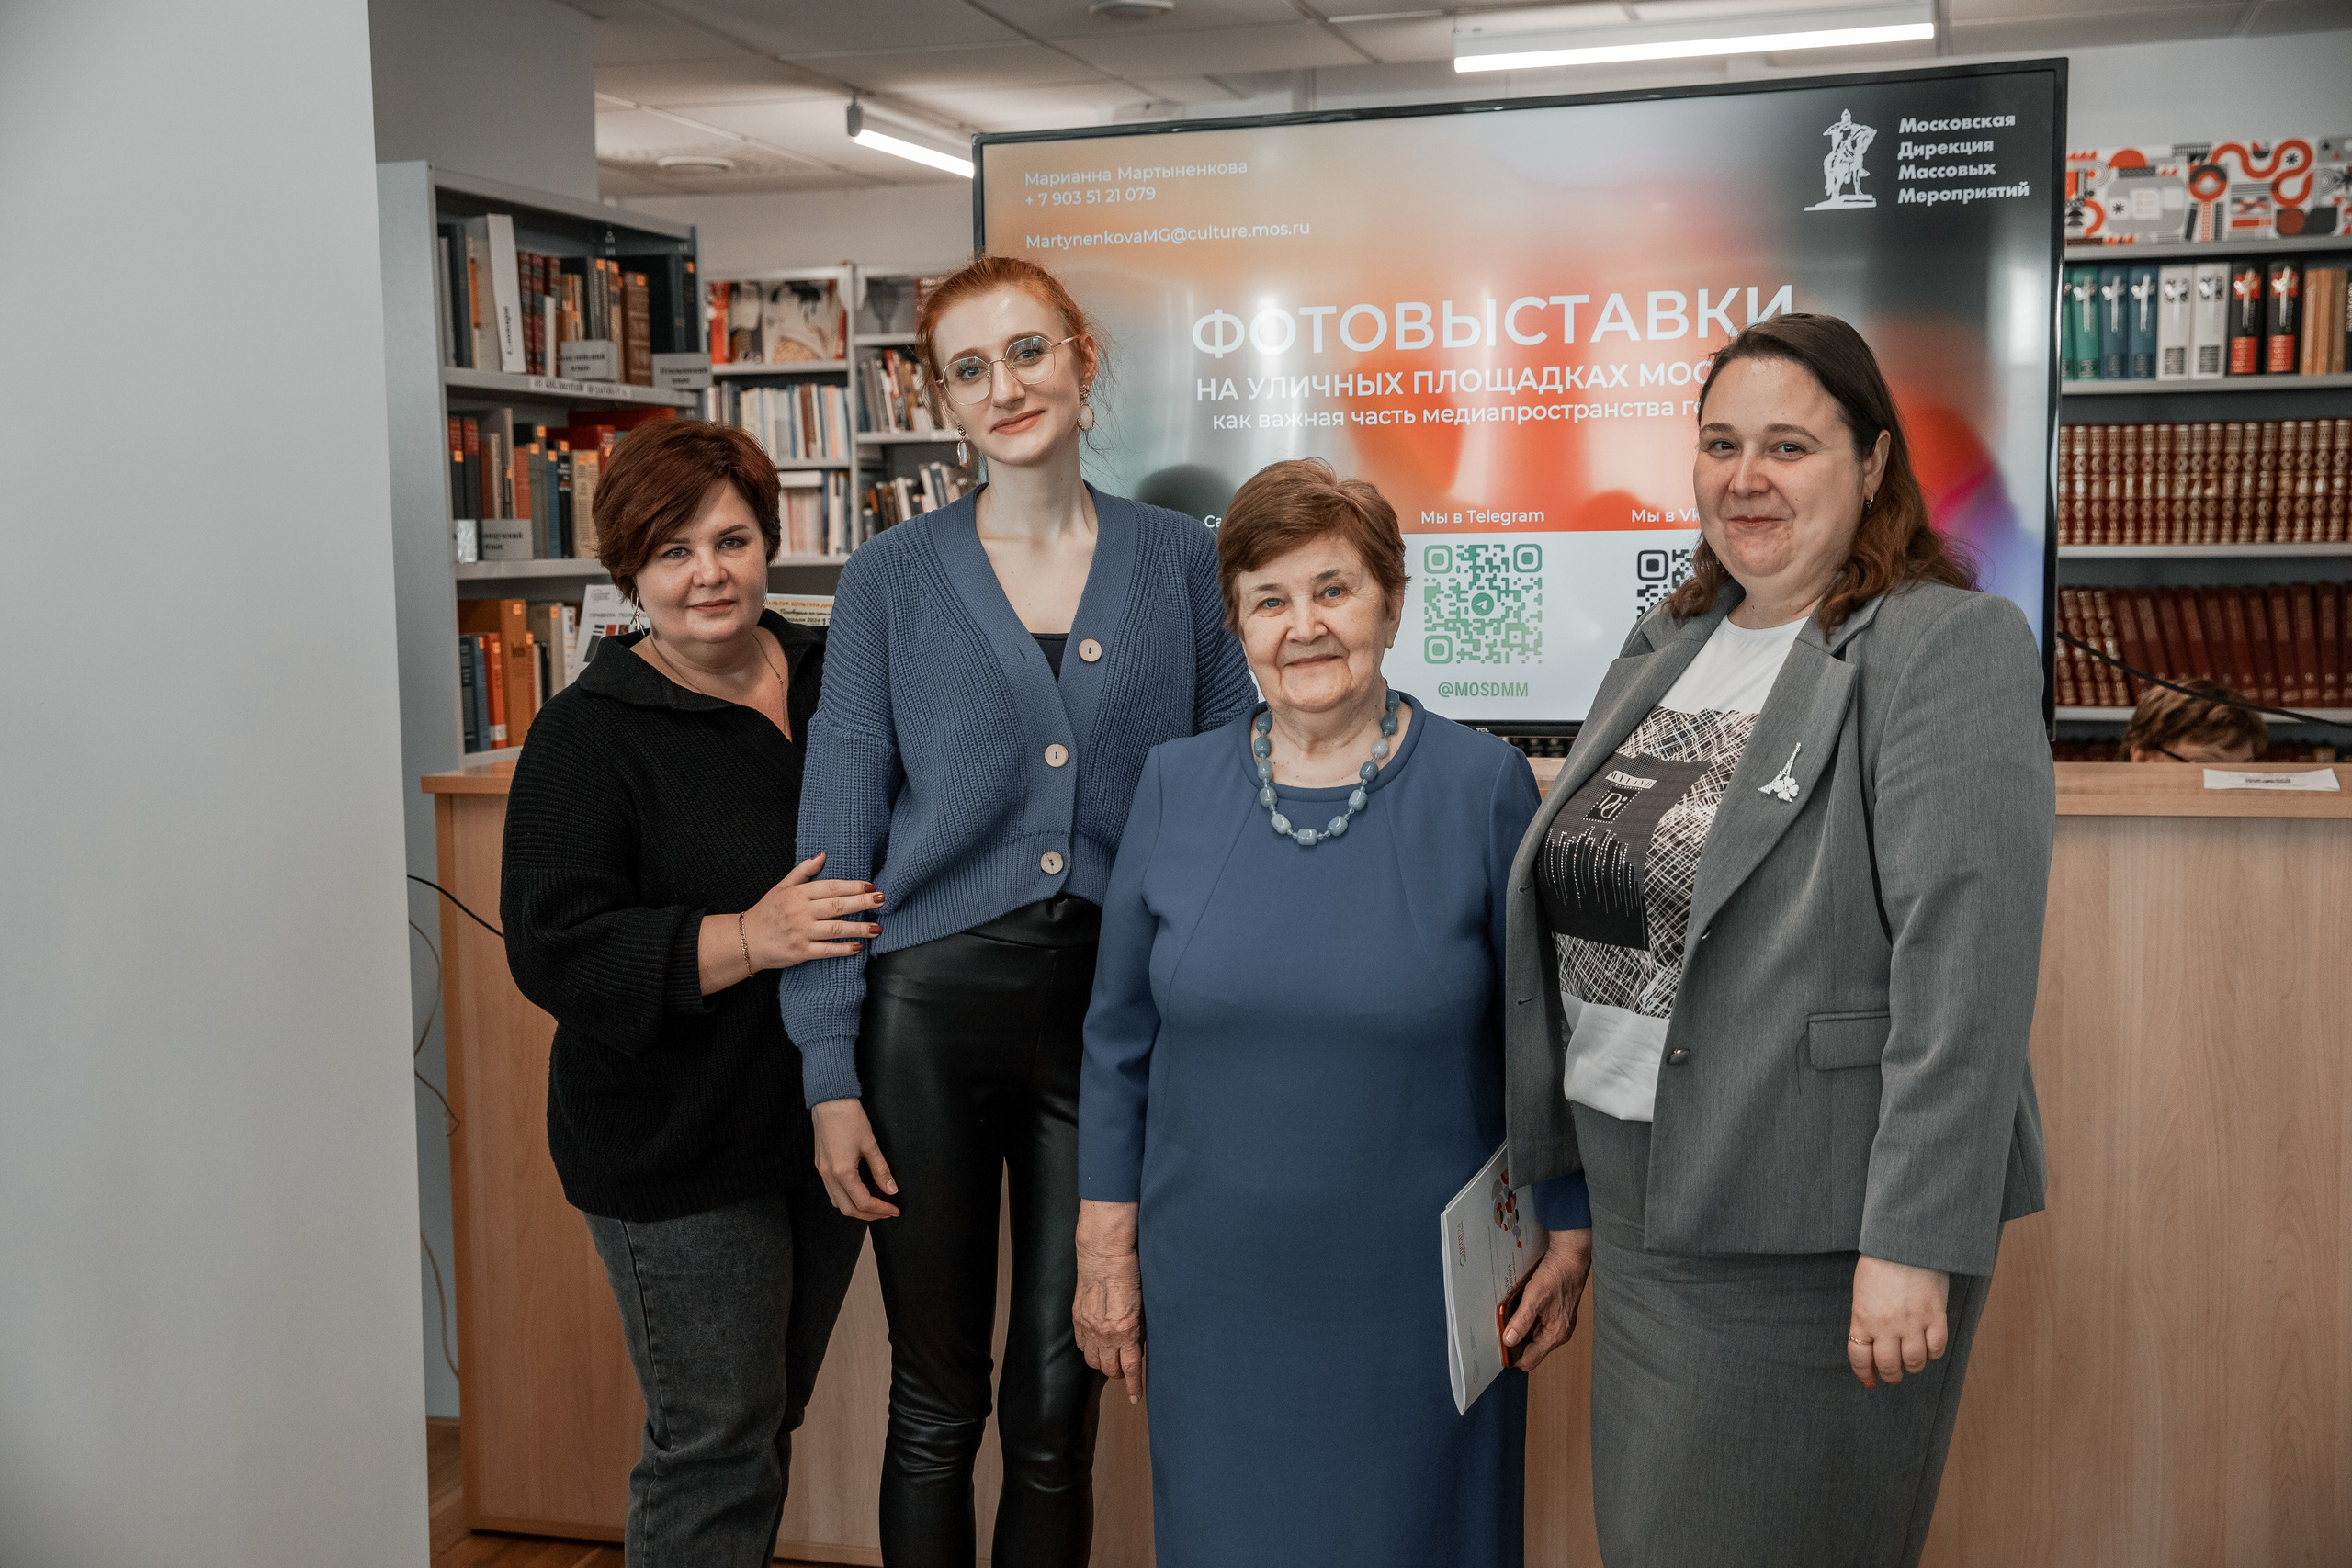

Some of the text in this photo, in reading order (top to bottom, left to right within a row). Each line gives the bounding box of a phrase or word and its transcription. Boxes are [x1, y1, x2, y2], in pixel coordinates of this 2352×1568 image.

[1898, 115, 2016, 134] Московская
[1897, 140, 1995, 160] Дирекция
[1024, 162, 1248, 187] Марианна Мартыненкова
[1897, 163, 1996, 180] Массовых
[1037, 192, 1048, 207] 7
[1051, 191, 1082, 206] 903
[1085, 189, 1101, 204] 51
[1105, 188, 1121, 203] 21
[1125, 186, 1156, 201] 079
[1897, 180, 2030, 206] Мероприятий
[1026, 223, 1311, 251] MartynenkovaMG@culture.mos.ru
[1193, 285, 1792, 359] ФОТОВЫСТАВКИ
[1197, 359, 1714, 401] НА УЛИЧНЫХ ПЛОЩАДКАХ МОС
[1213, 414, 1251, 430] как
[1259, 411, 1345, 428] важная
[1351, 409, 1416, 426] часть
[1422, 401, 1674, 426] медиапространства
[1204, 514, 1222, 528] Са
[1420, 509, 1545, 526] Мы в Telegram
[1631, 509, 1660, 523] Мы
[1665, 511, 1676, 522] в
[1438, 682, 1529, 698] @MOSDMM
